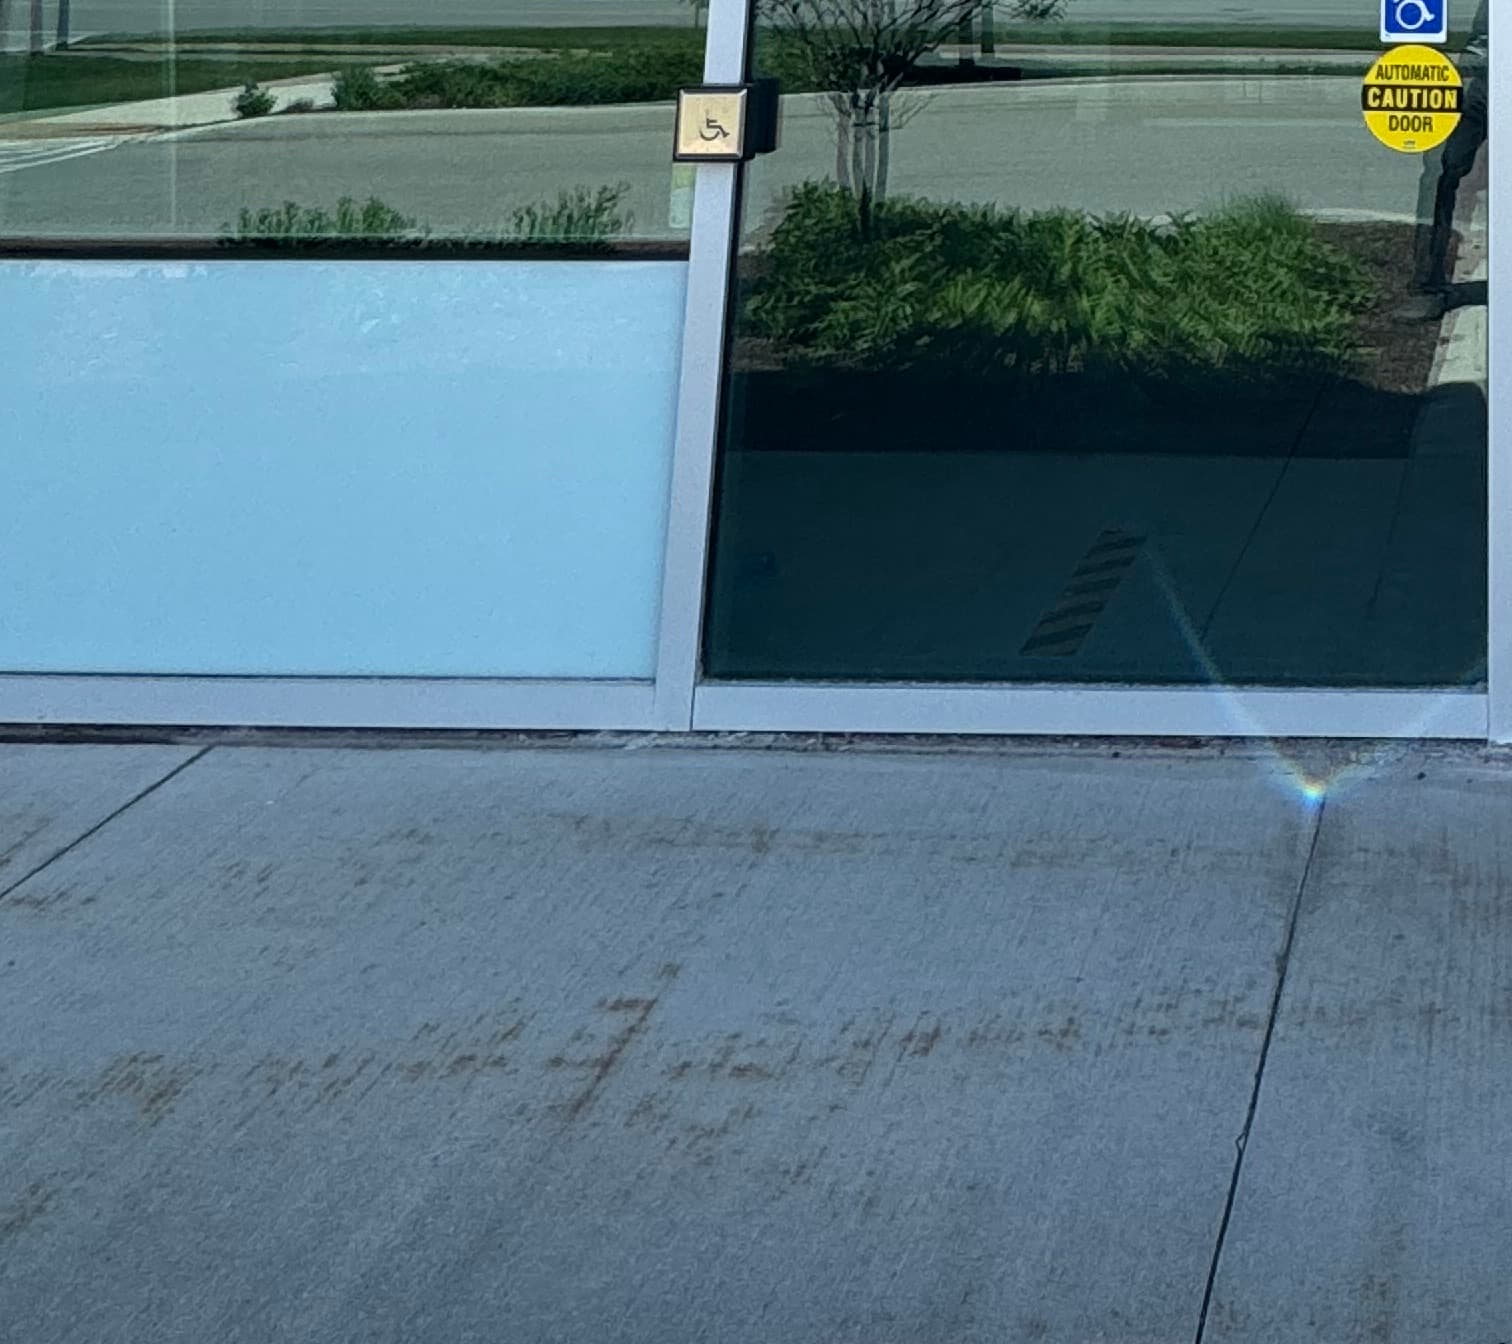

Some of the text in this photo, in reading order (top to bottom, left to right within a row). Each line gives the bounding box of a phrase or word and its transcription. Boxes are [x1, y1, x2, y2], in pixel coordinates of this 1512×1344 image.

[1375, 64, 1450, 82] AUTOMATIC
[1367, 86, 1458, 110] CAUTION
[1388, 115, 1434, 132] DOOR
